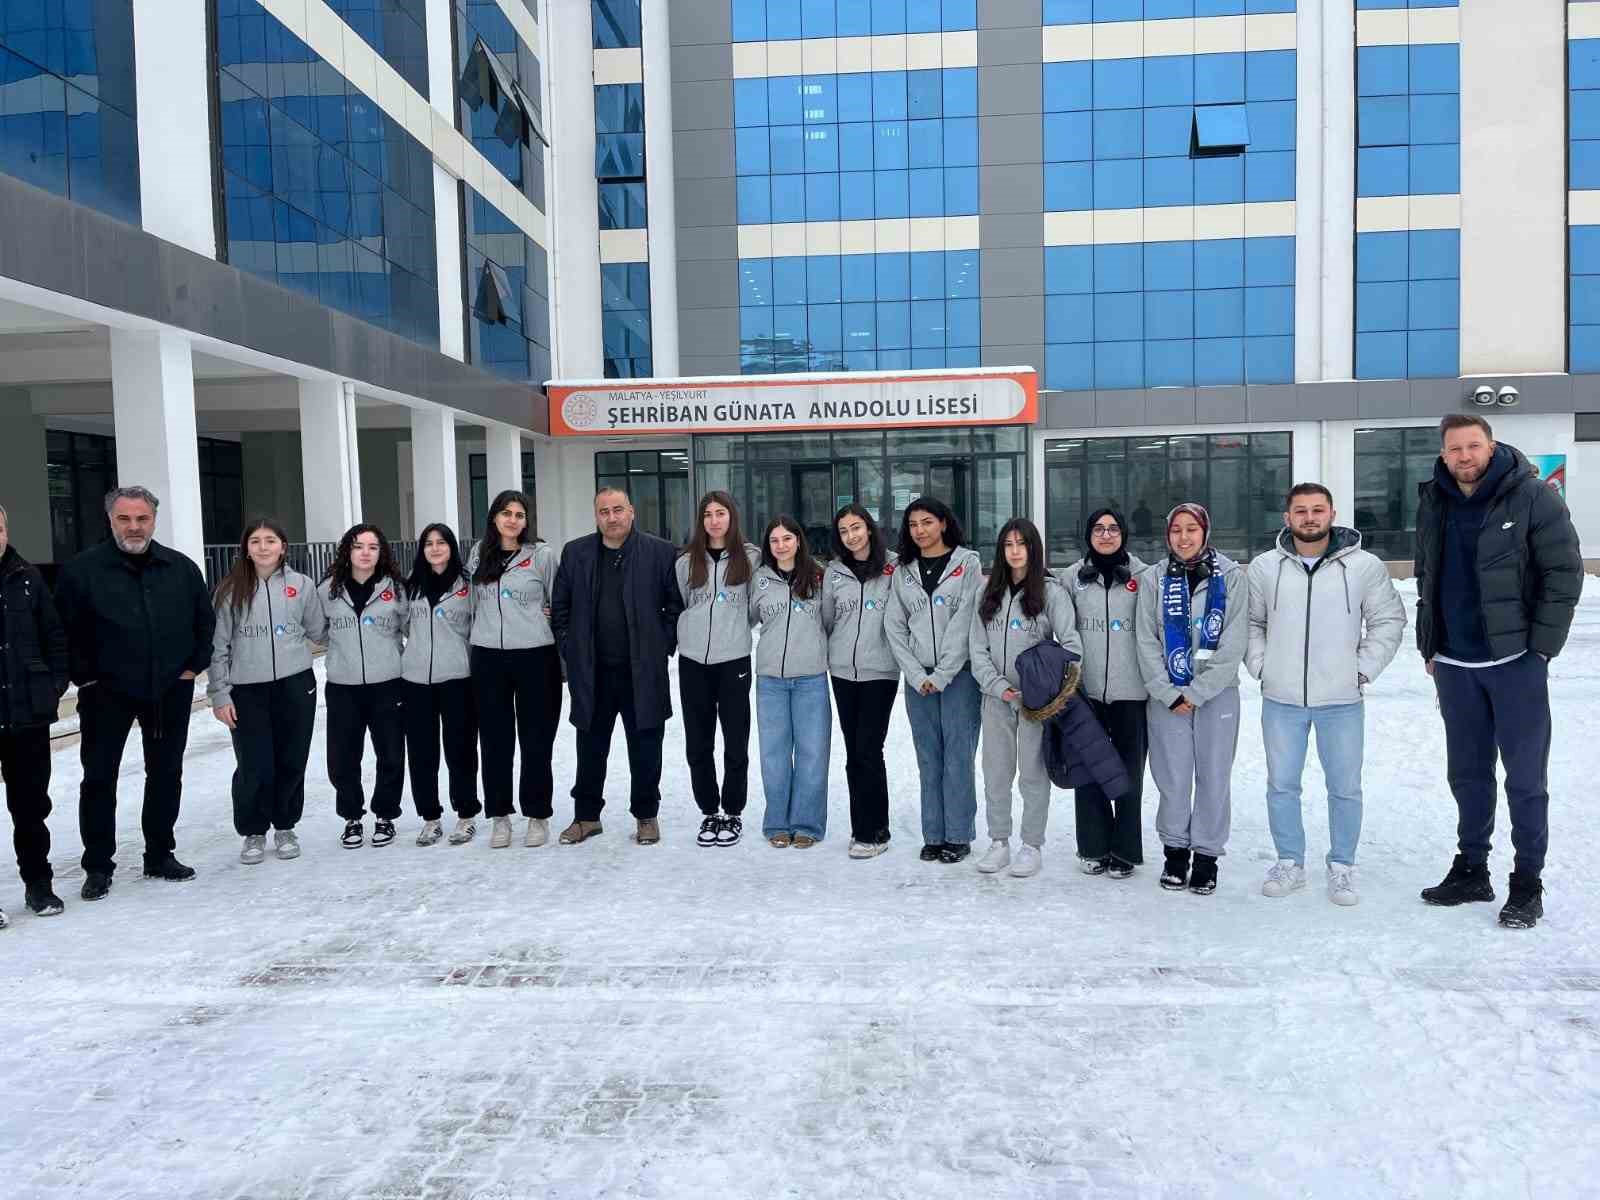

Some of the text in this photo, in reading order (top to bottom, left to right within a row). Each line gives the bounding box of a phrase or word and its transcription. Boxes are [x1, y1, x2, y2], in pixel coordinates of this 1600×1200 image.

[608, 391, 653, 401] MALATYA
[607, 402, 707, 428] ŞEHRİBAN
[714, 401, 796, 421] GÜNATA
[809, 399, 911, 418] ANADOLU
[916, 393, 978, 415] LİSESİ
